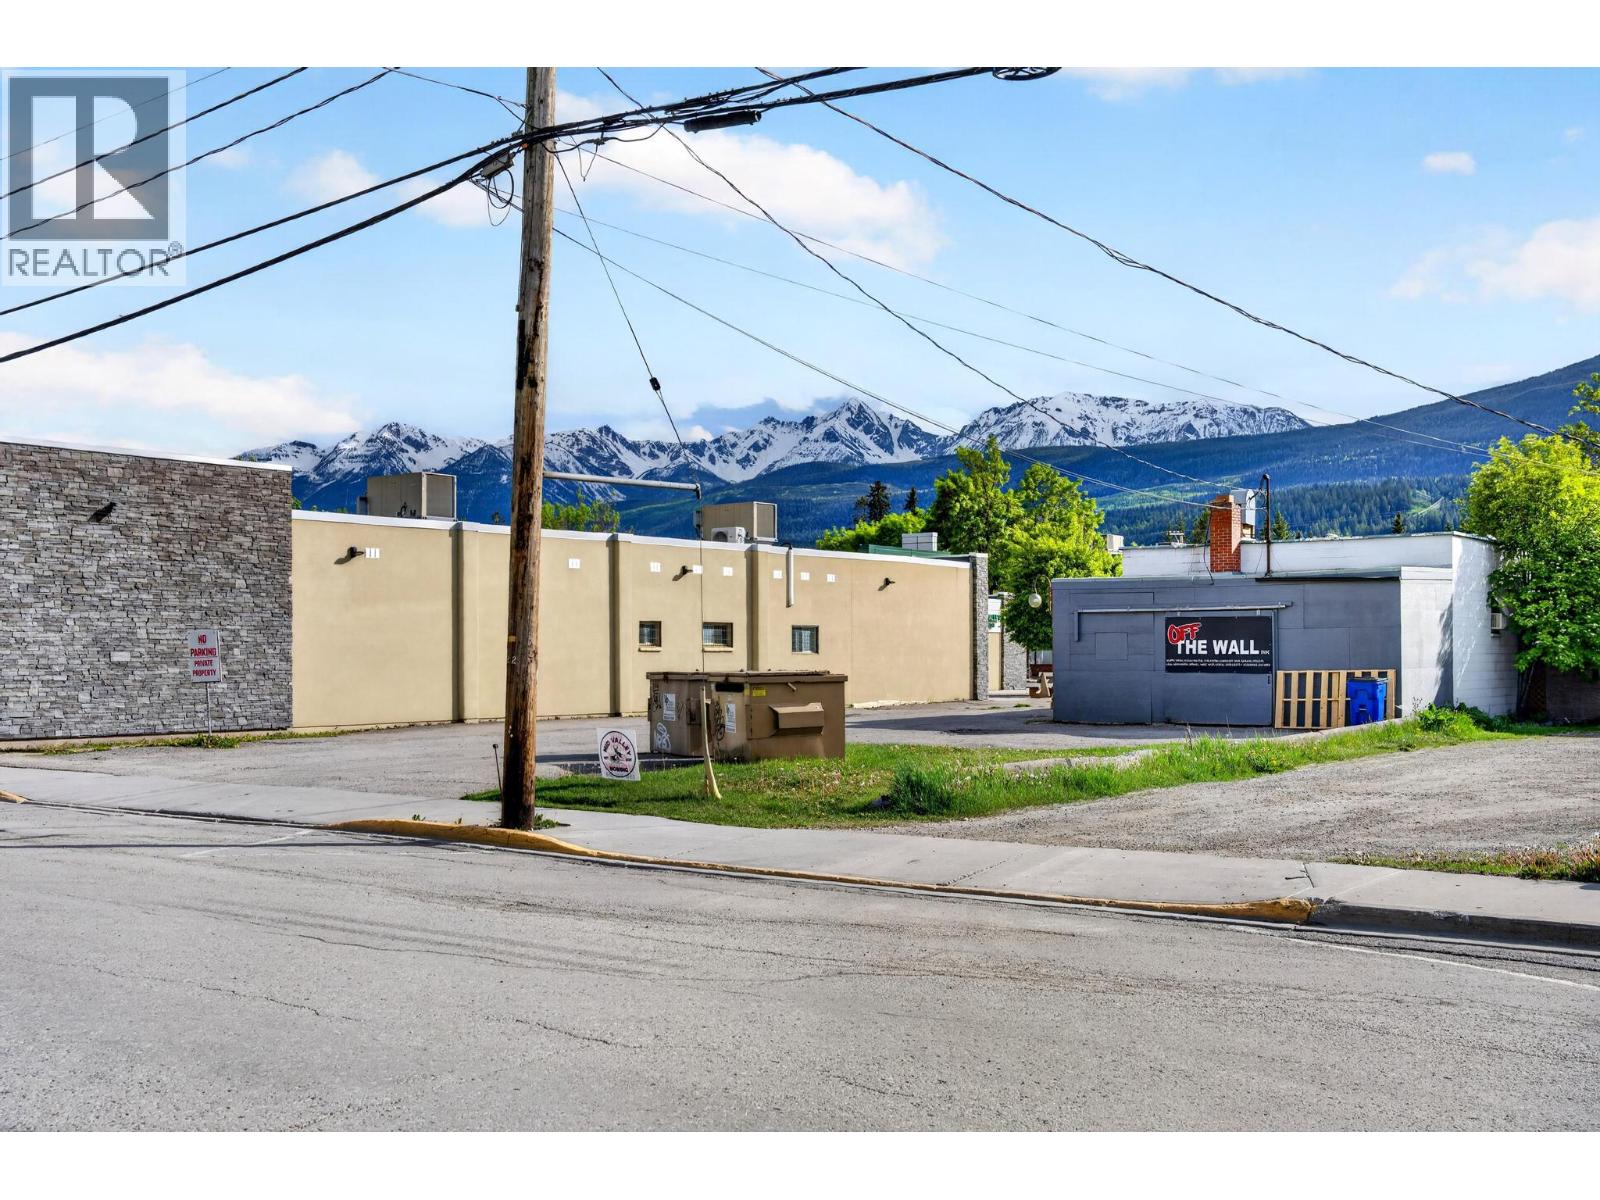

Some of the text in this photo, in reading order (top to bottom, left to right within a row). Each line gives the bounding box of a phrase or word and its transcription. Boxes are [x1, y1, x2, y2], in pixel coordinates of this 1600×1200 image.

[1167, 622, 1202, 645] OFF
[197, 634, 207, 644] NO
[190, 647, 217, 657] PARKING
[1177, 639, 1208, 655] THE
[1212, 639, 1260, 654] WALL
[193, 659, 213, 667] PRIVATE
[192, 669, 217, 677] PROPERTY
[610, 736, 632, 756] VALLEY
